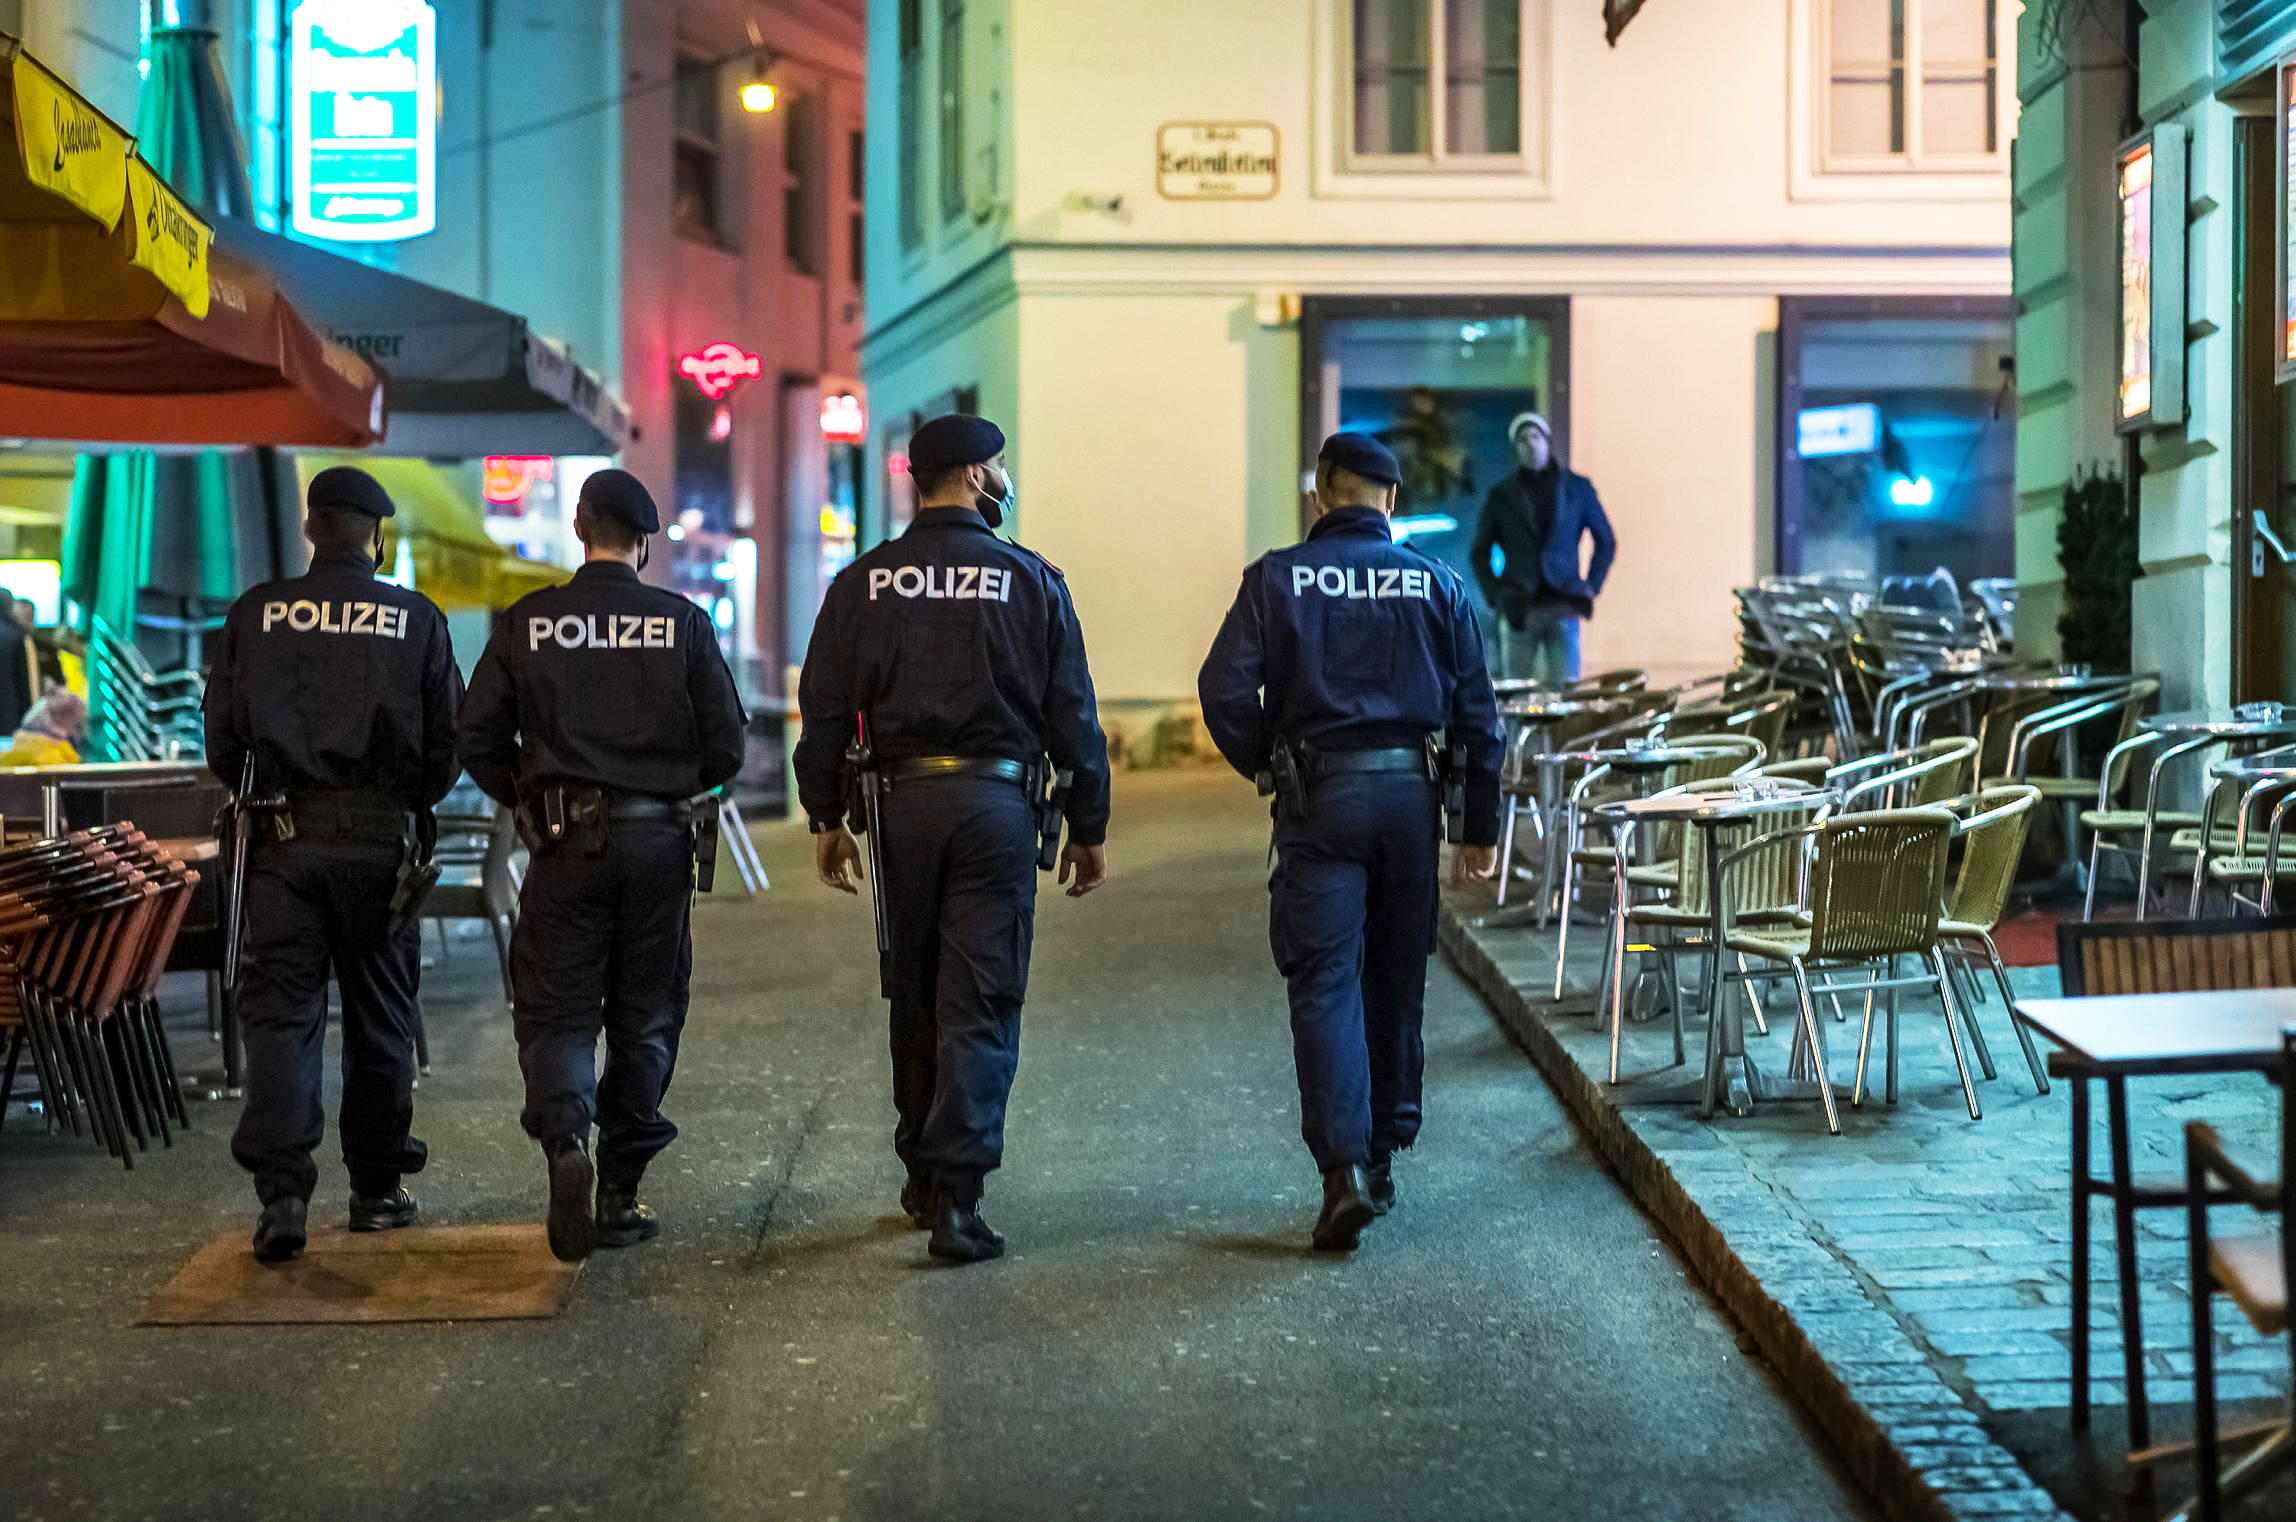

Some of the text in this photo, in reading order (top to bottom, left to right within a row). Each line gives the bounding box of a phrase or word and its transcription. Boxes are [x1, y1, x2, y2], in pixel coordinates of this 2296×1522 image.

[868, 565, 1012, 603] POLIZEI
[1291, 565, 1431, 601] POLIZEI
[263, 599, 409, 640] POLIZEI
[528, 614, 675, 650] POLIZEI
